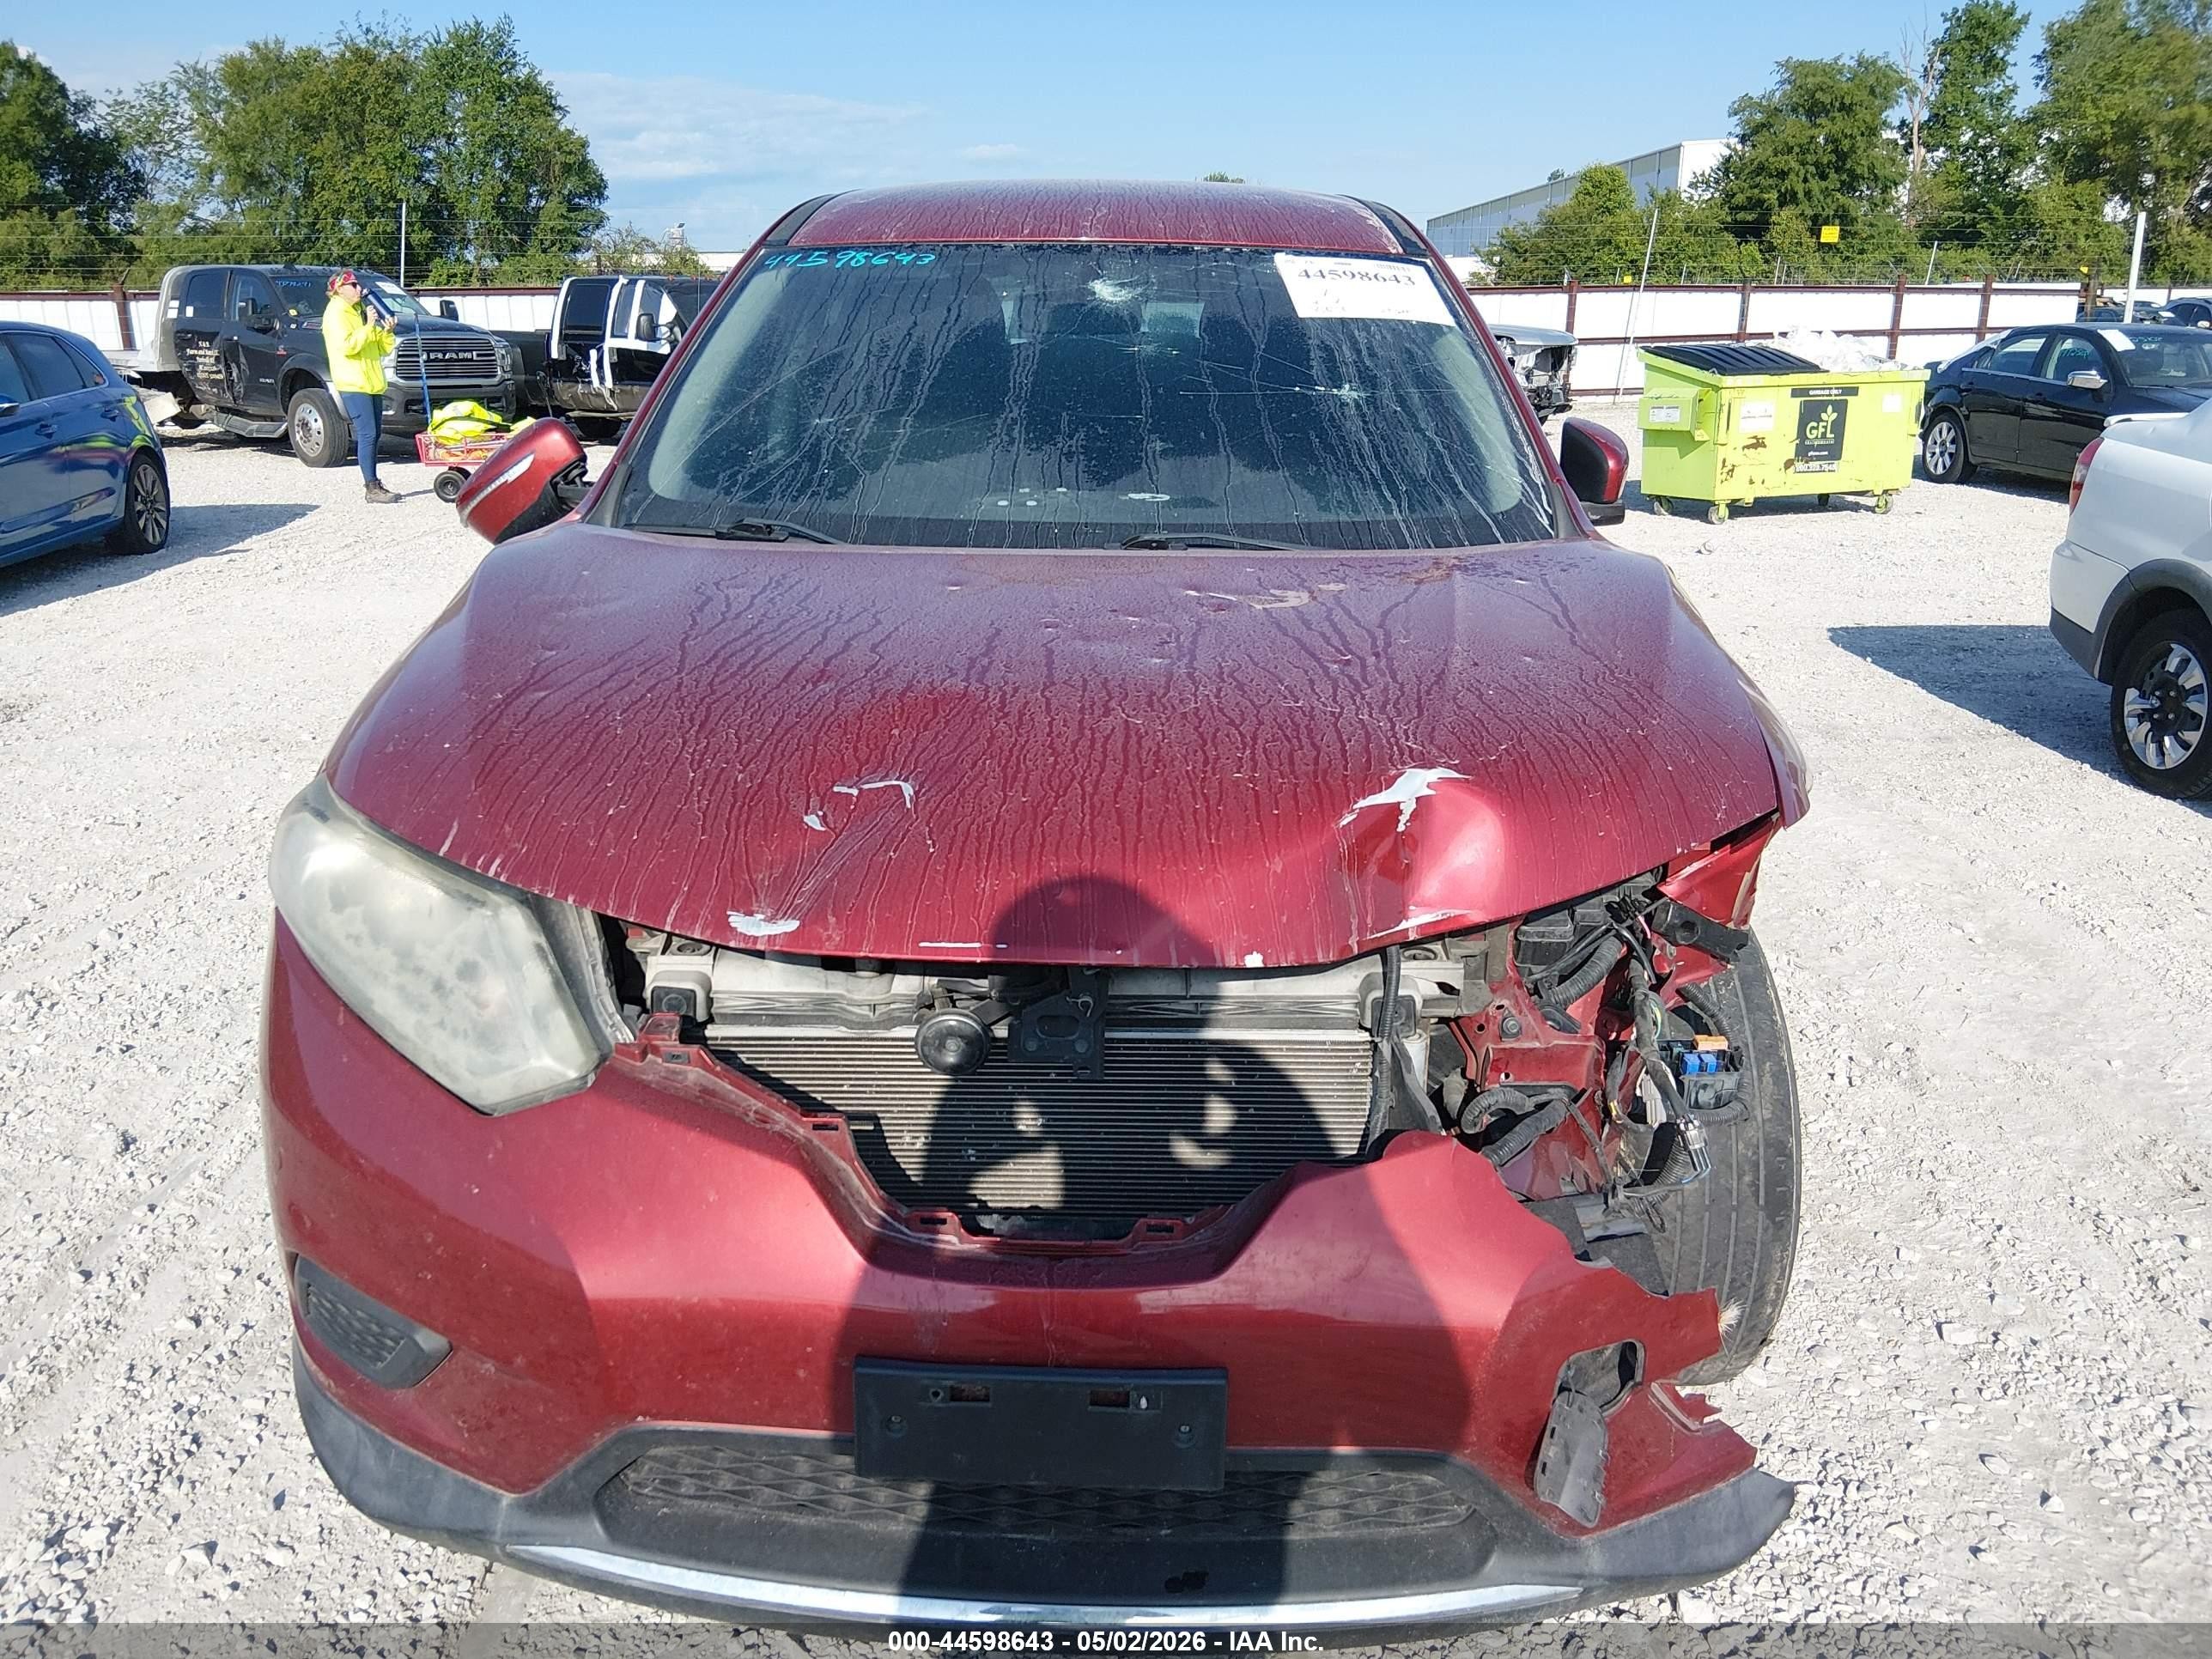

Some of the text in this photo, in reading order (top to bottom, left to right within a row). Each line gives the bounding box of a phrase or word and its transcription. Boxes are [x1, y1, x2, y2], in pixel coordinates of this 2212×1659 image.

[764, 250, 936, 269] 44598643
[1297, 268, 1416, 286] 44598643
[429, 351, 472, 360] RAM
[1806, 417, 1835, 439] GFL
